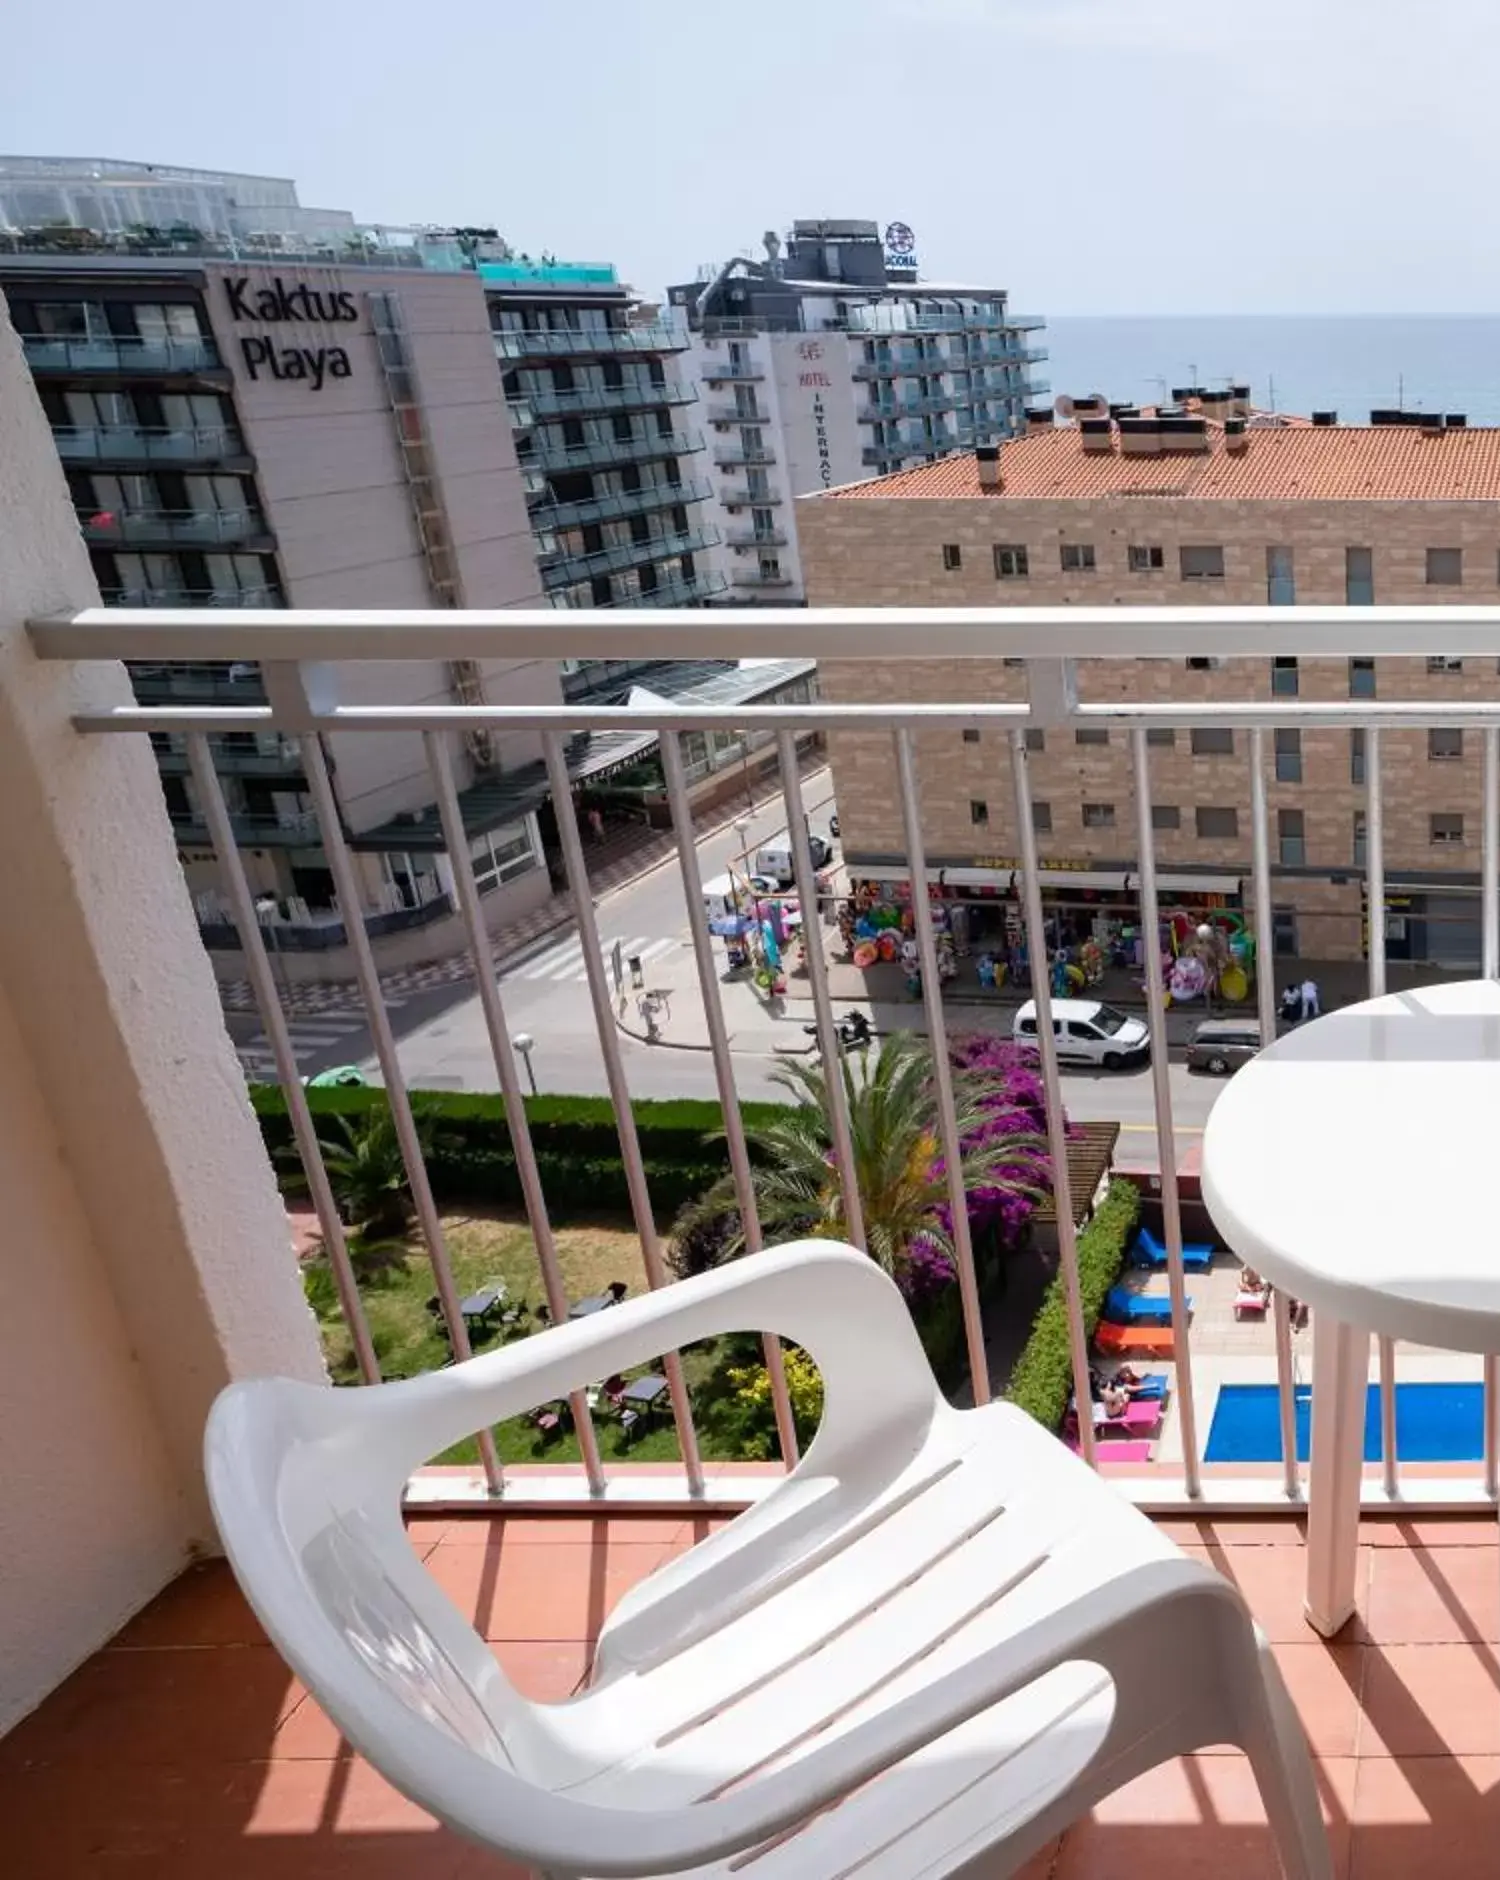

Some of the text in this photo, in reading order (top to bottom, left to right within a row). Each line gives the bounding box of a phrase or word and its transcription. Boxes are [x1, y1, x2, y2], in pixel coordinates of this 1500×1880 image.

[223, 278, 358, 321] Kaktus
[241, 336, 352, 391] Playa
[800, 373, 832, 387] HOTEL
